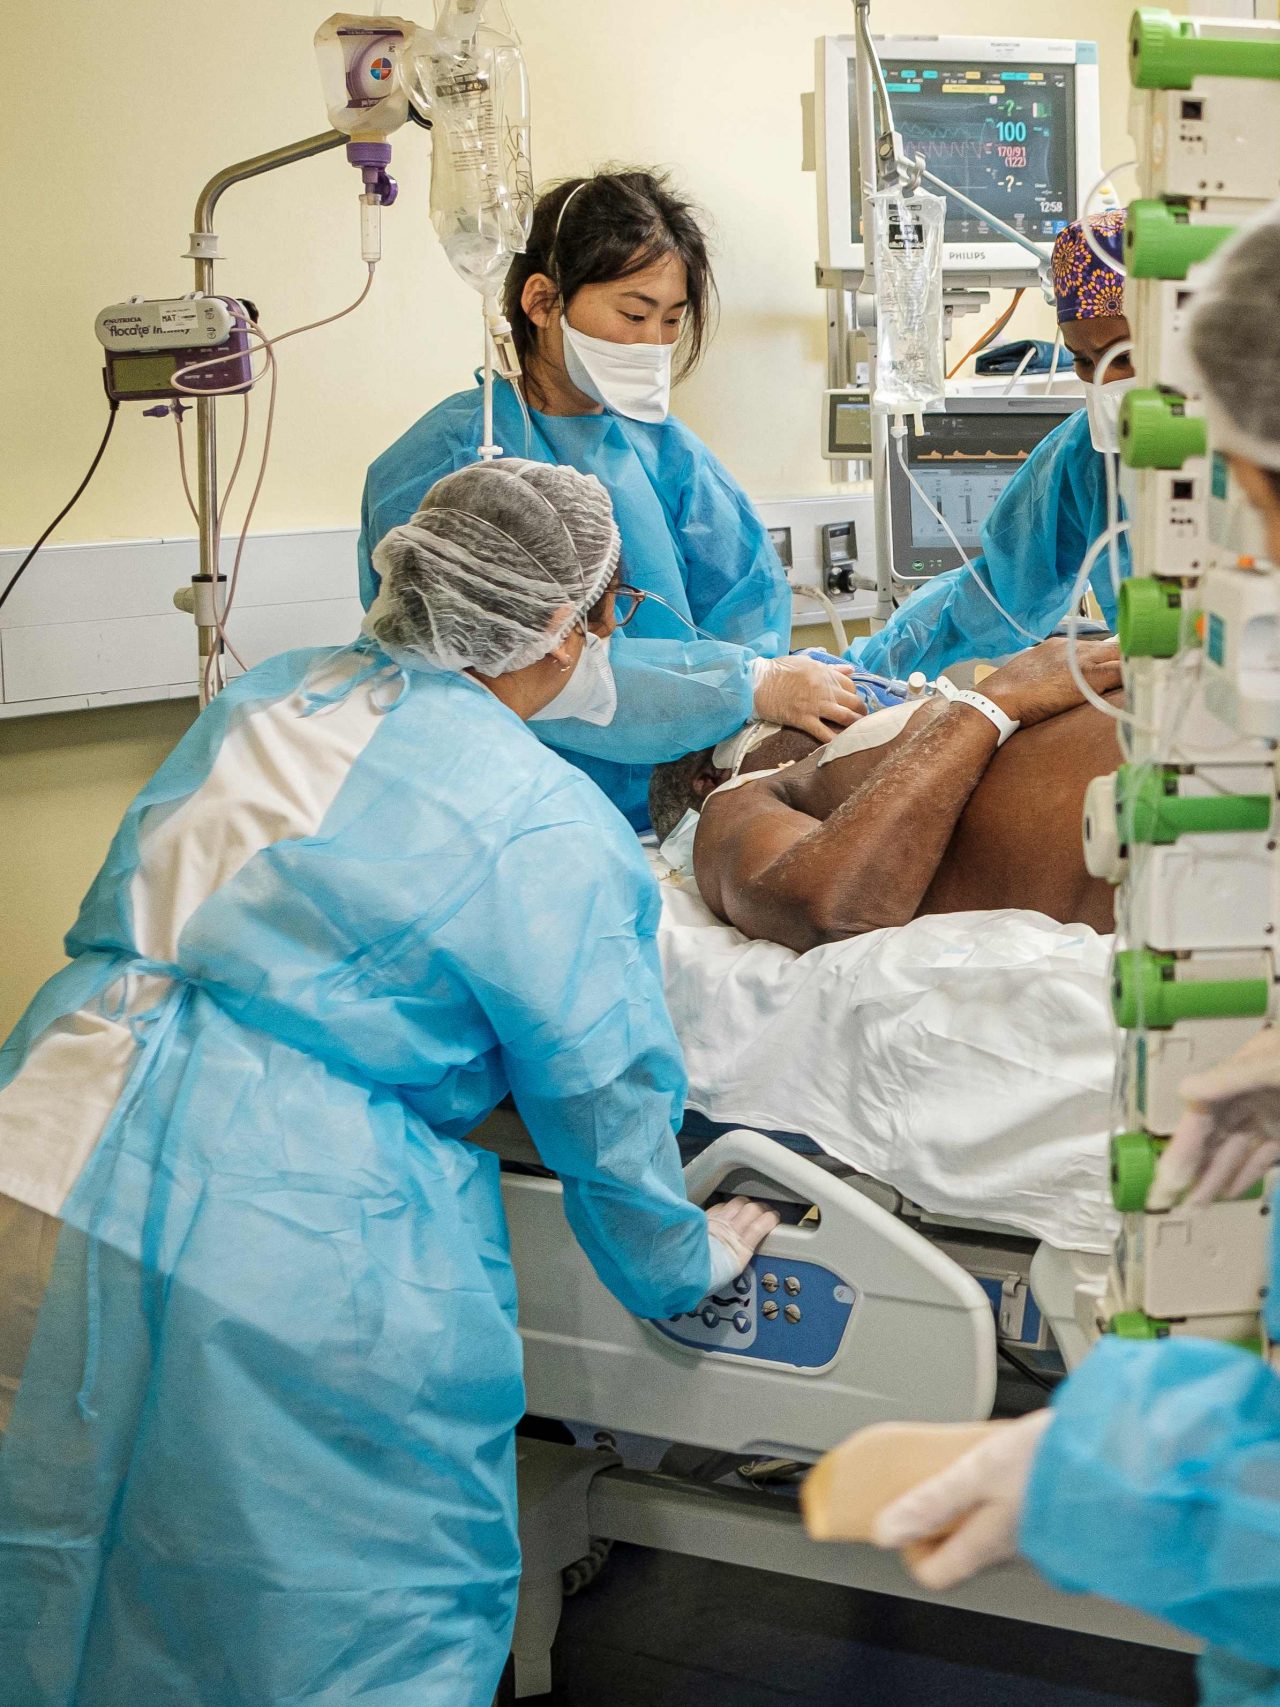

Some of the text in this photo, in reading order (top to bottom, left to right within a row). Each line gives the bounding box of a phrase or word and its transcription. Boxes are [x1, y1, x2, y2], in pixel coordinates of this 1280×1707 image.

[995, 121, 1027, 142] 100
[997, 145, 1026, 158] 170/91
[1004, 156, 1027, 168] (122)
[949, 251, 986, 260] PHILIPS
